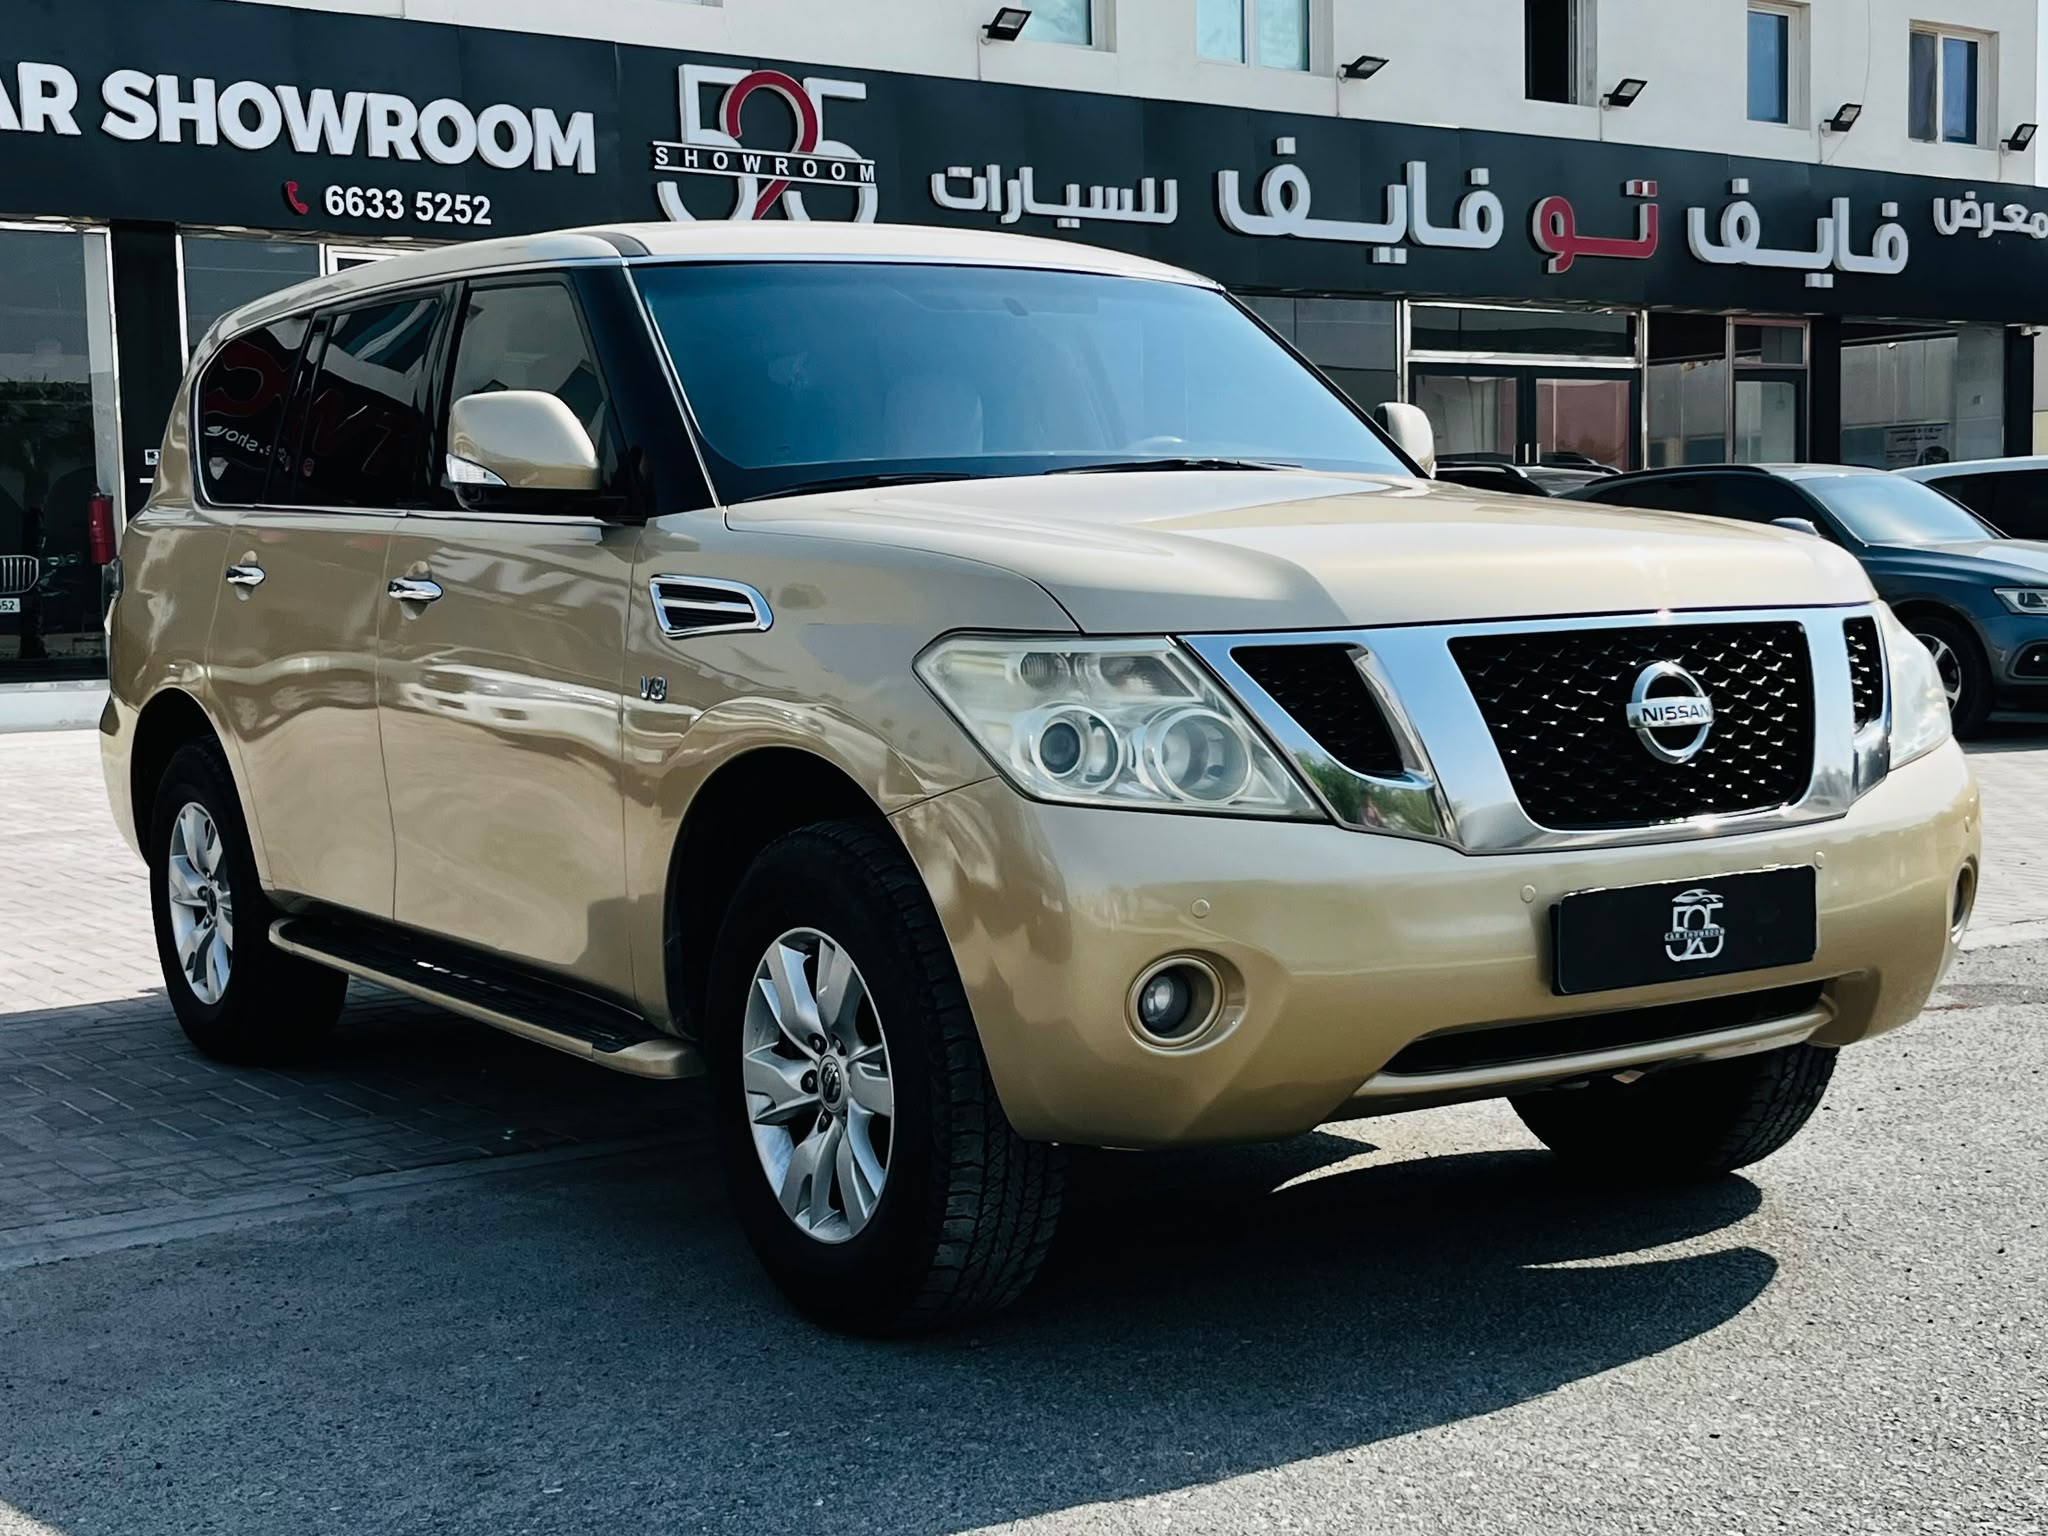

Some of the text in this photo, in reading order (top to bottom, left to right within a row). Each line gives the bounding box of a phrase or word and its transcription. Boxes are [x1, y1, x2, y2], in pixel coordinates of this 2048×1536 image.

[101, 69, 596, 174] SHOWROOM
[655, 146, 876, 184] SHOWROOM
[325, 184, 493, 226] 6633 5252
[930, 136, 2048, 288] معرض فايف تو فايف للسيارات
[1641, 703, 1711, 722] NISSAN
